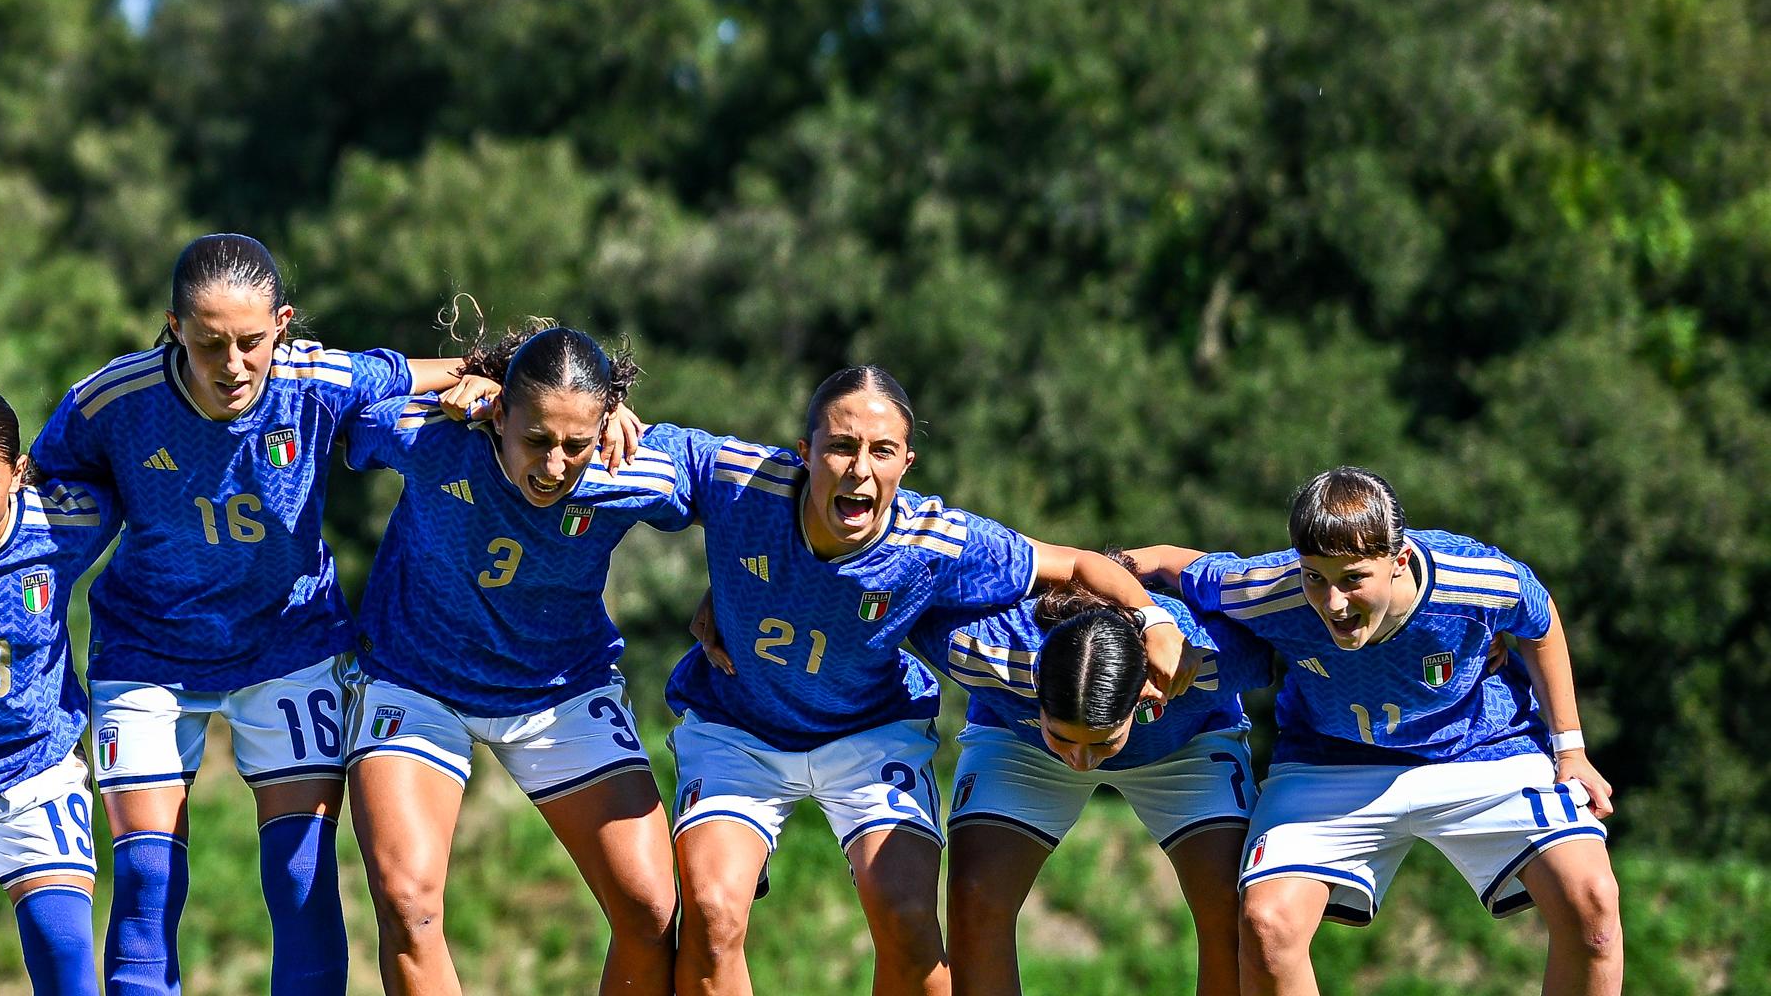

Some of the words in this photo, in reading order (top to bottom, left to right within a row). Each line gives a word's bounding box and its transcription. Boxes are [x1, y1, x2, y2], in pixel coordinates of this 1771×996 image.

[268, 432, 292, 444] ITALIA
[194, 493, 265, 544] 16
[567, 506, 591, 514] ITALIA
[24, 574, 47, 585] ITALIA
[478, 537, 523, 588] 3
[864, 593, 888, 601] ITALIA
[754, 617, 827, 674] 21
[1426, 655, 1450, 664] ITALIA
[277, 688, 341, 761] 16
[377, 708, 402, 717] ITALIA
[588, 696, 640, 752] 3
[100, 730, 116, 740] ITALIA
[1209, 752, 1247, 810] 7
[42, 792, 92, 854] 19
[1522, 783, 1578, 827] 11
